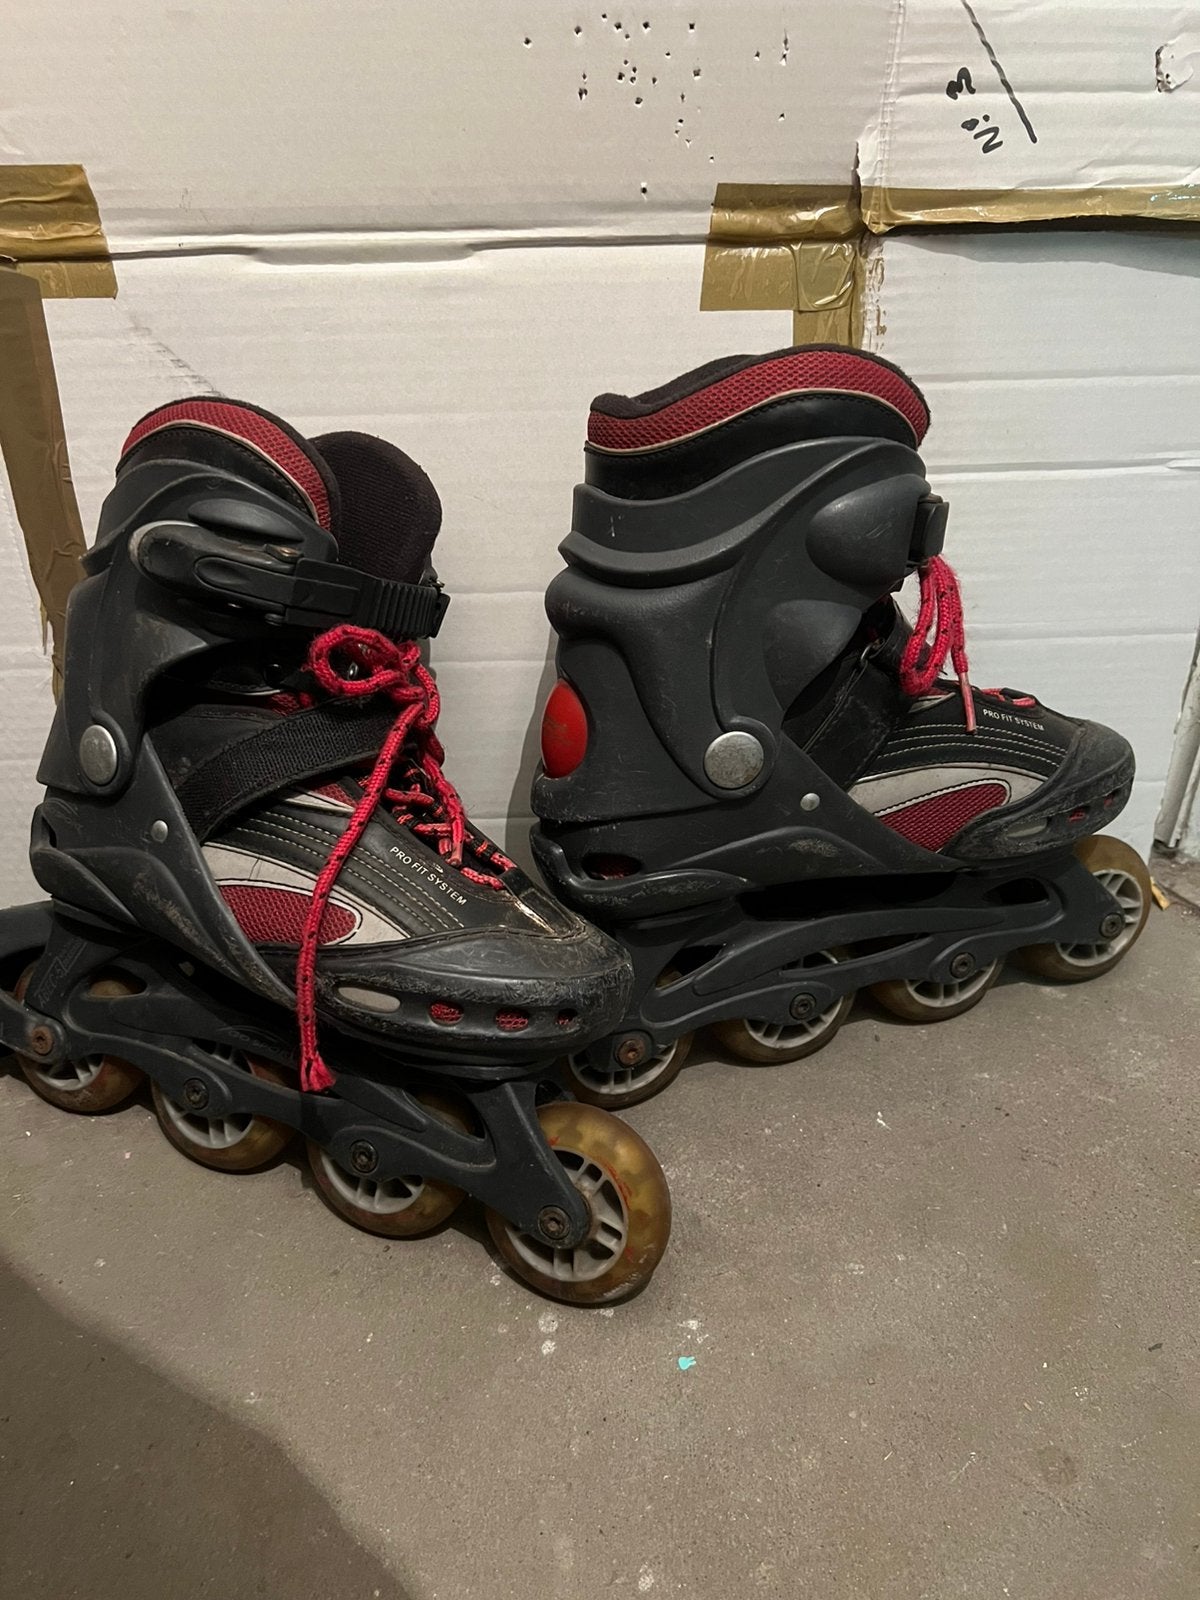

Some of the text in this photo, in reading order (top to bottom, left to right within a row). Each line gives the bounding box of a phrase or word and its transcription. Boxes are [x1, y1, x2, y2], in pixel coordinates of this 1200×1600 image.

[982, 708, 1045, 731] PRO FIT SYSTEM
[389, 846, 468, 906] PRO FIT SYSTEM
